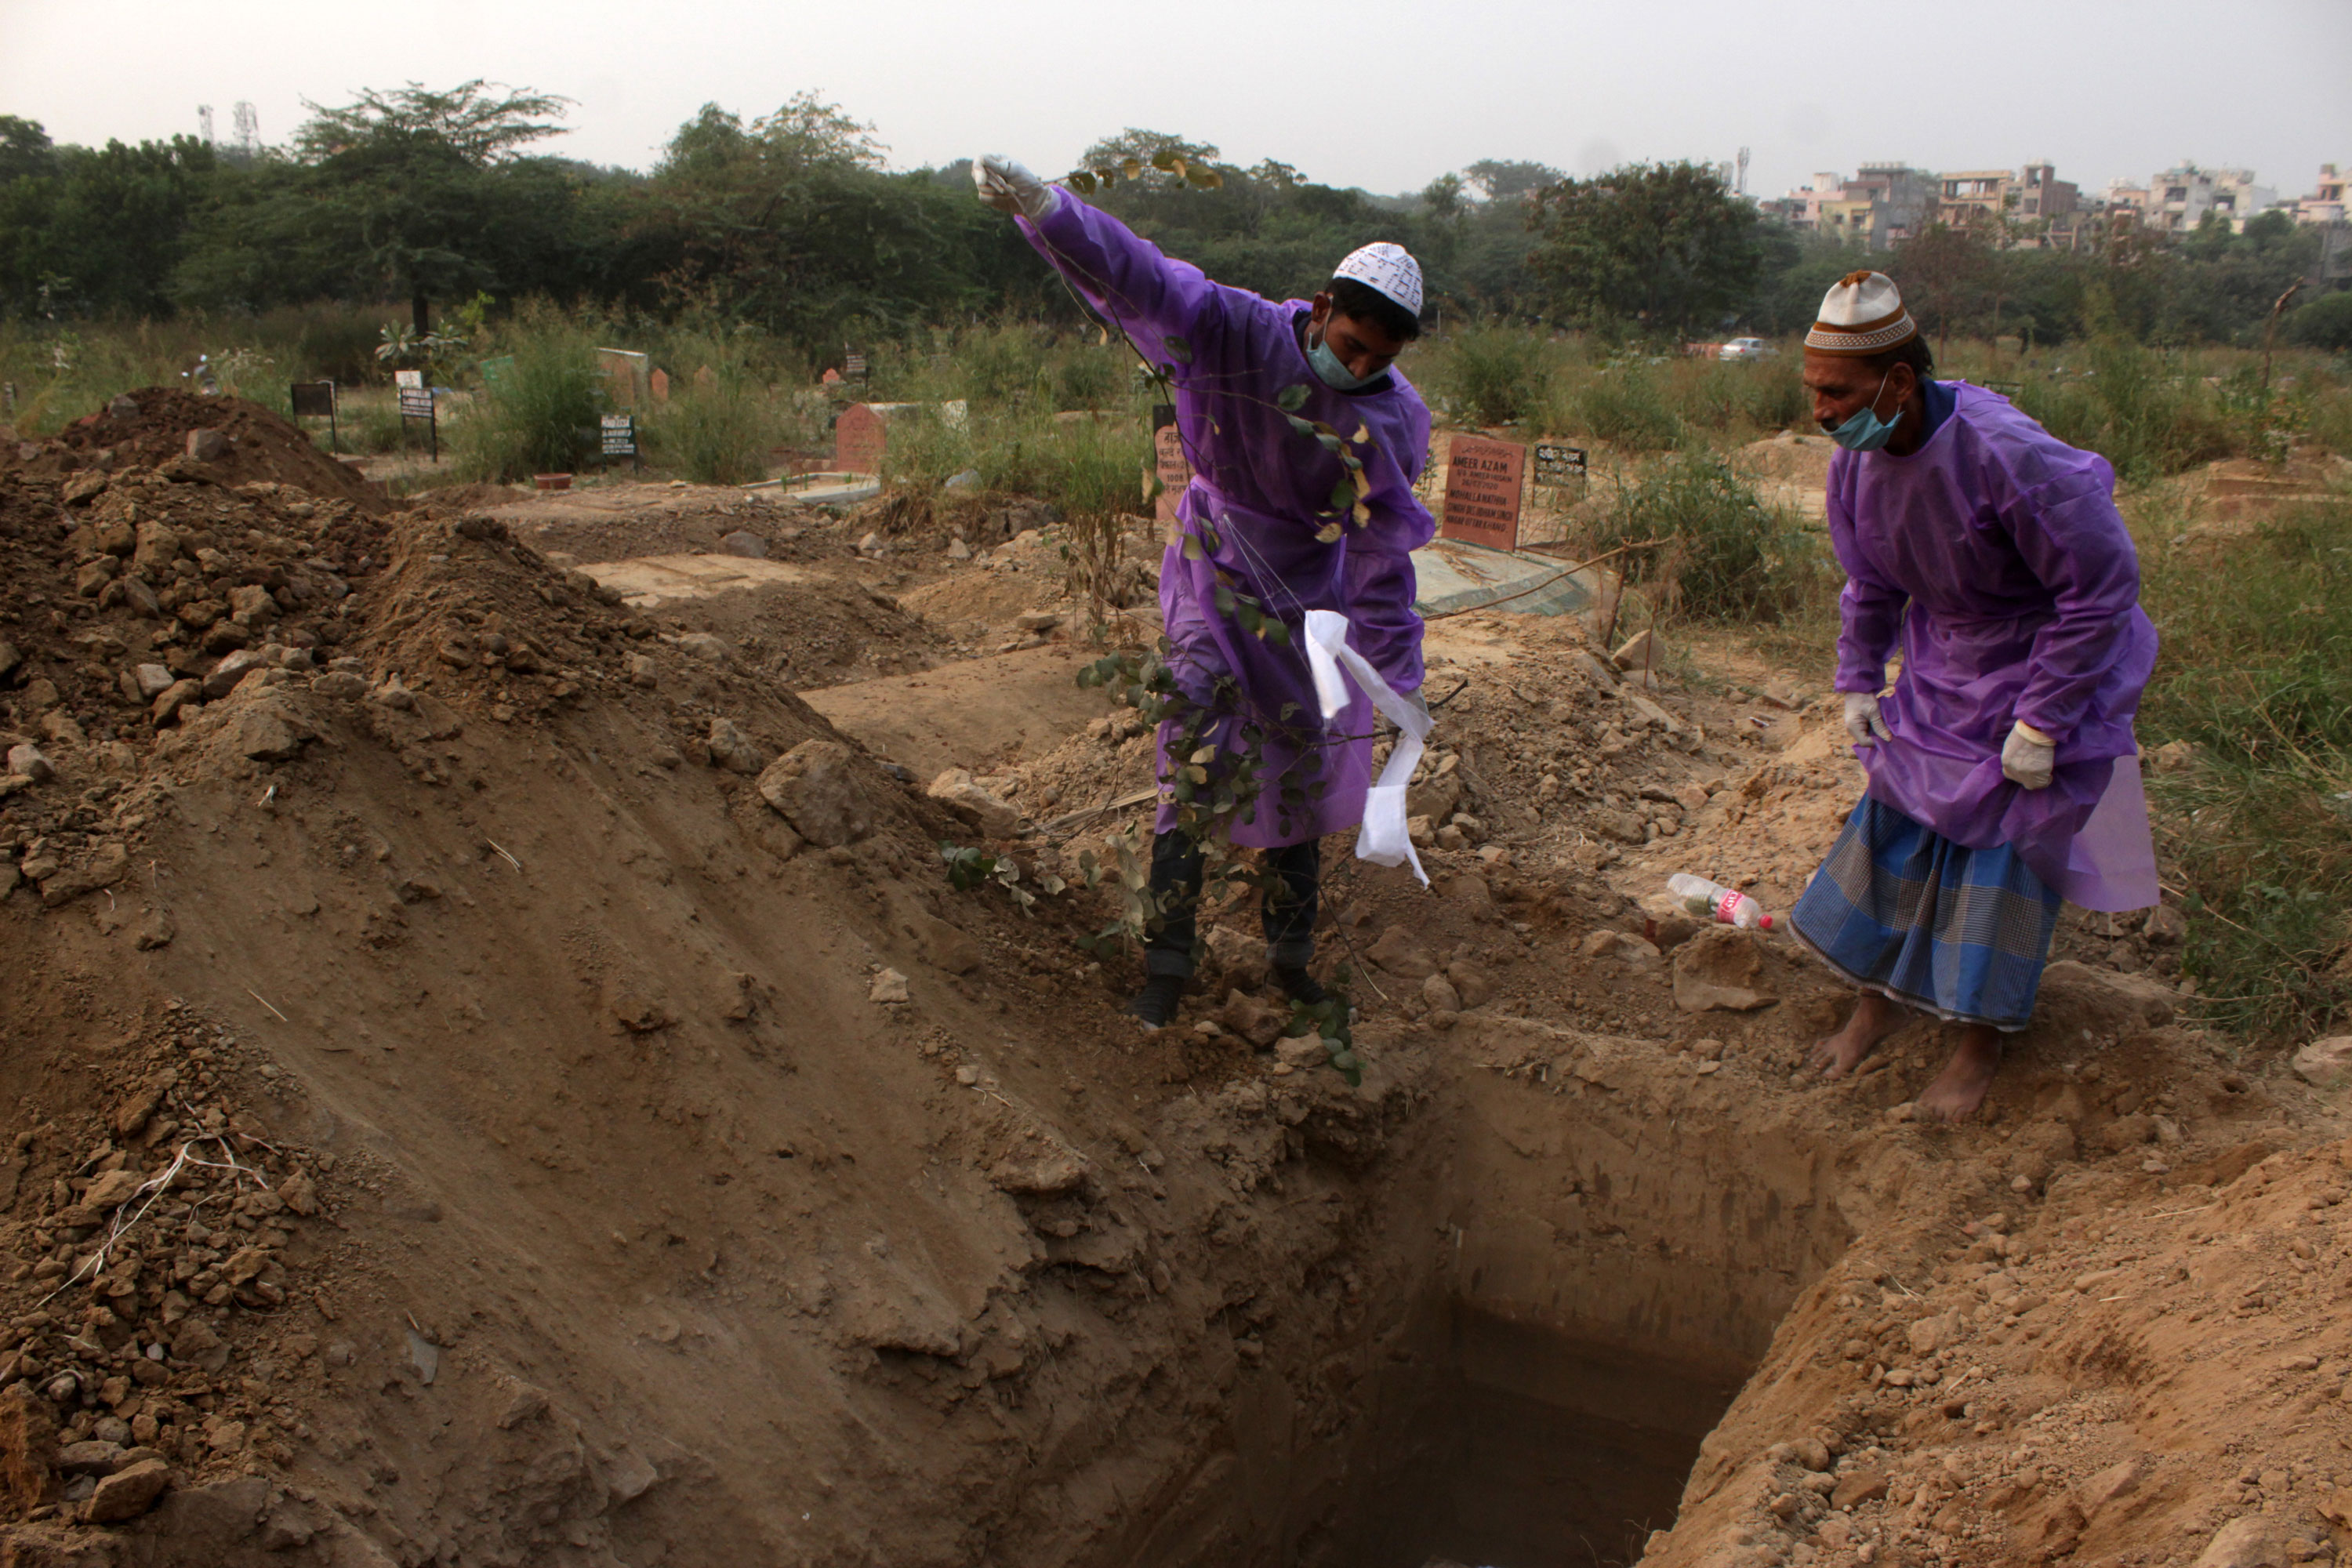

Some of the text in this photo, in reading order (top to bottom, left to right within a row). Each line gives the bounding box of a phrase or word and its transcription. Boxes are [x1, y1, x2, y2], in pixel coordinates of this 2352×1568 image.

[1453, 456, 1508, 474] AMEER AZAM
[1449, 489, 1481, 503] MOHALLA
